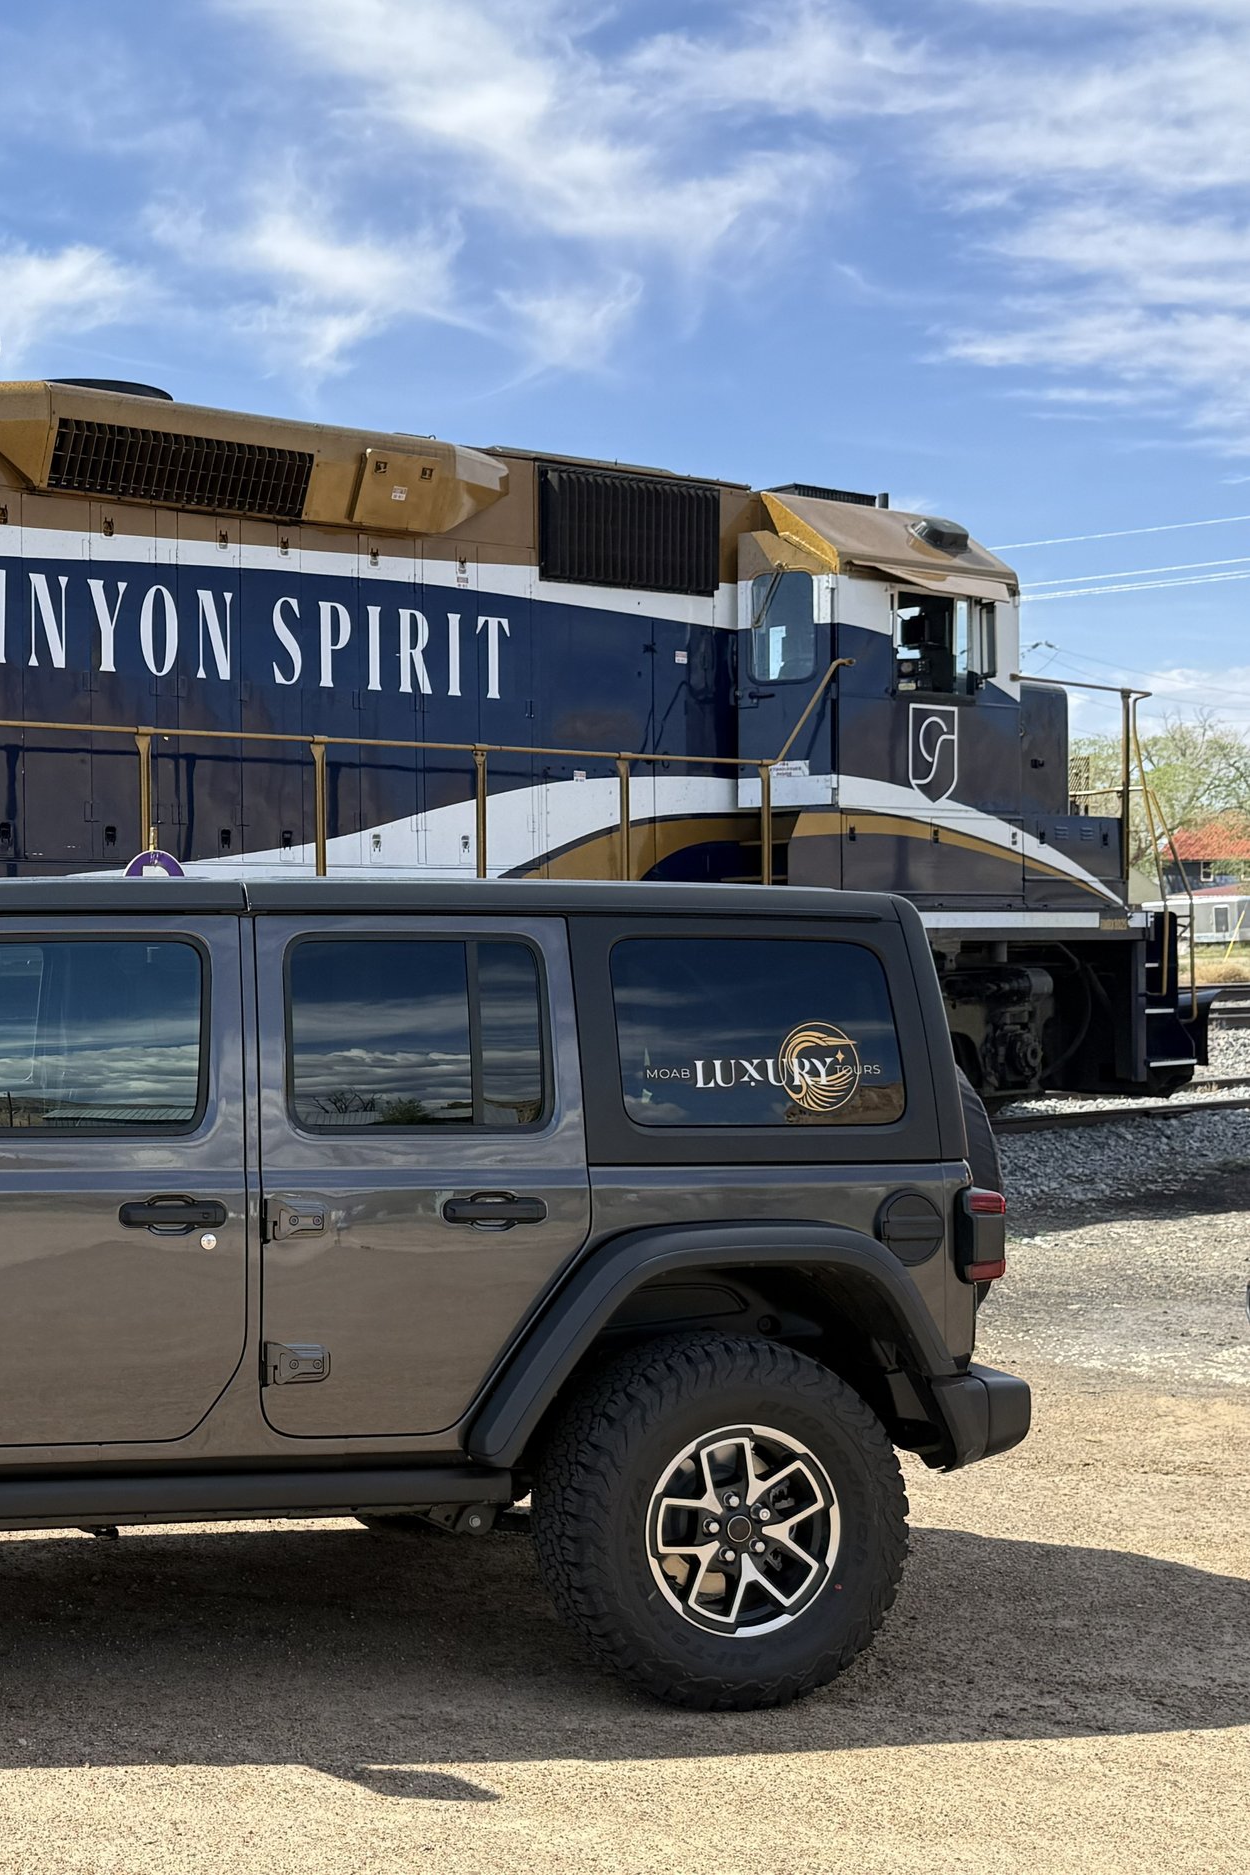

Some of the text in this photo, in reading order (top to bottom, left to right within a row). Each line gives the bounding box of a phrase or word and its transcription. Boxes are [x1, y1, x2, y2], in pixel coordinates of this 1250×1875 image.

[272, 596, 510, 700] SPIRIT
[646, 1057, 882, 1089] MOAB LUXURY TOURS
